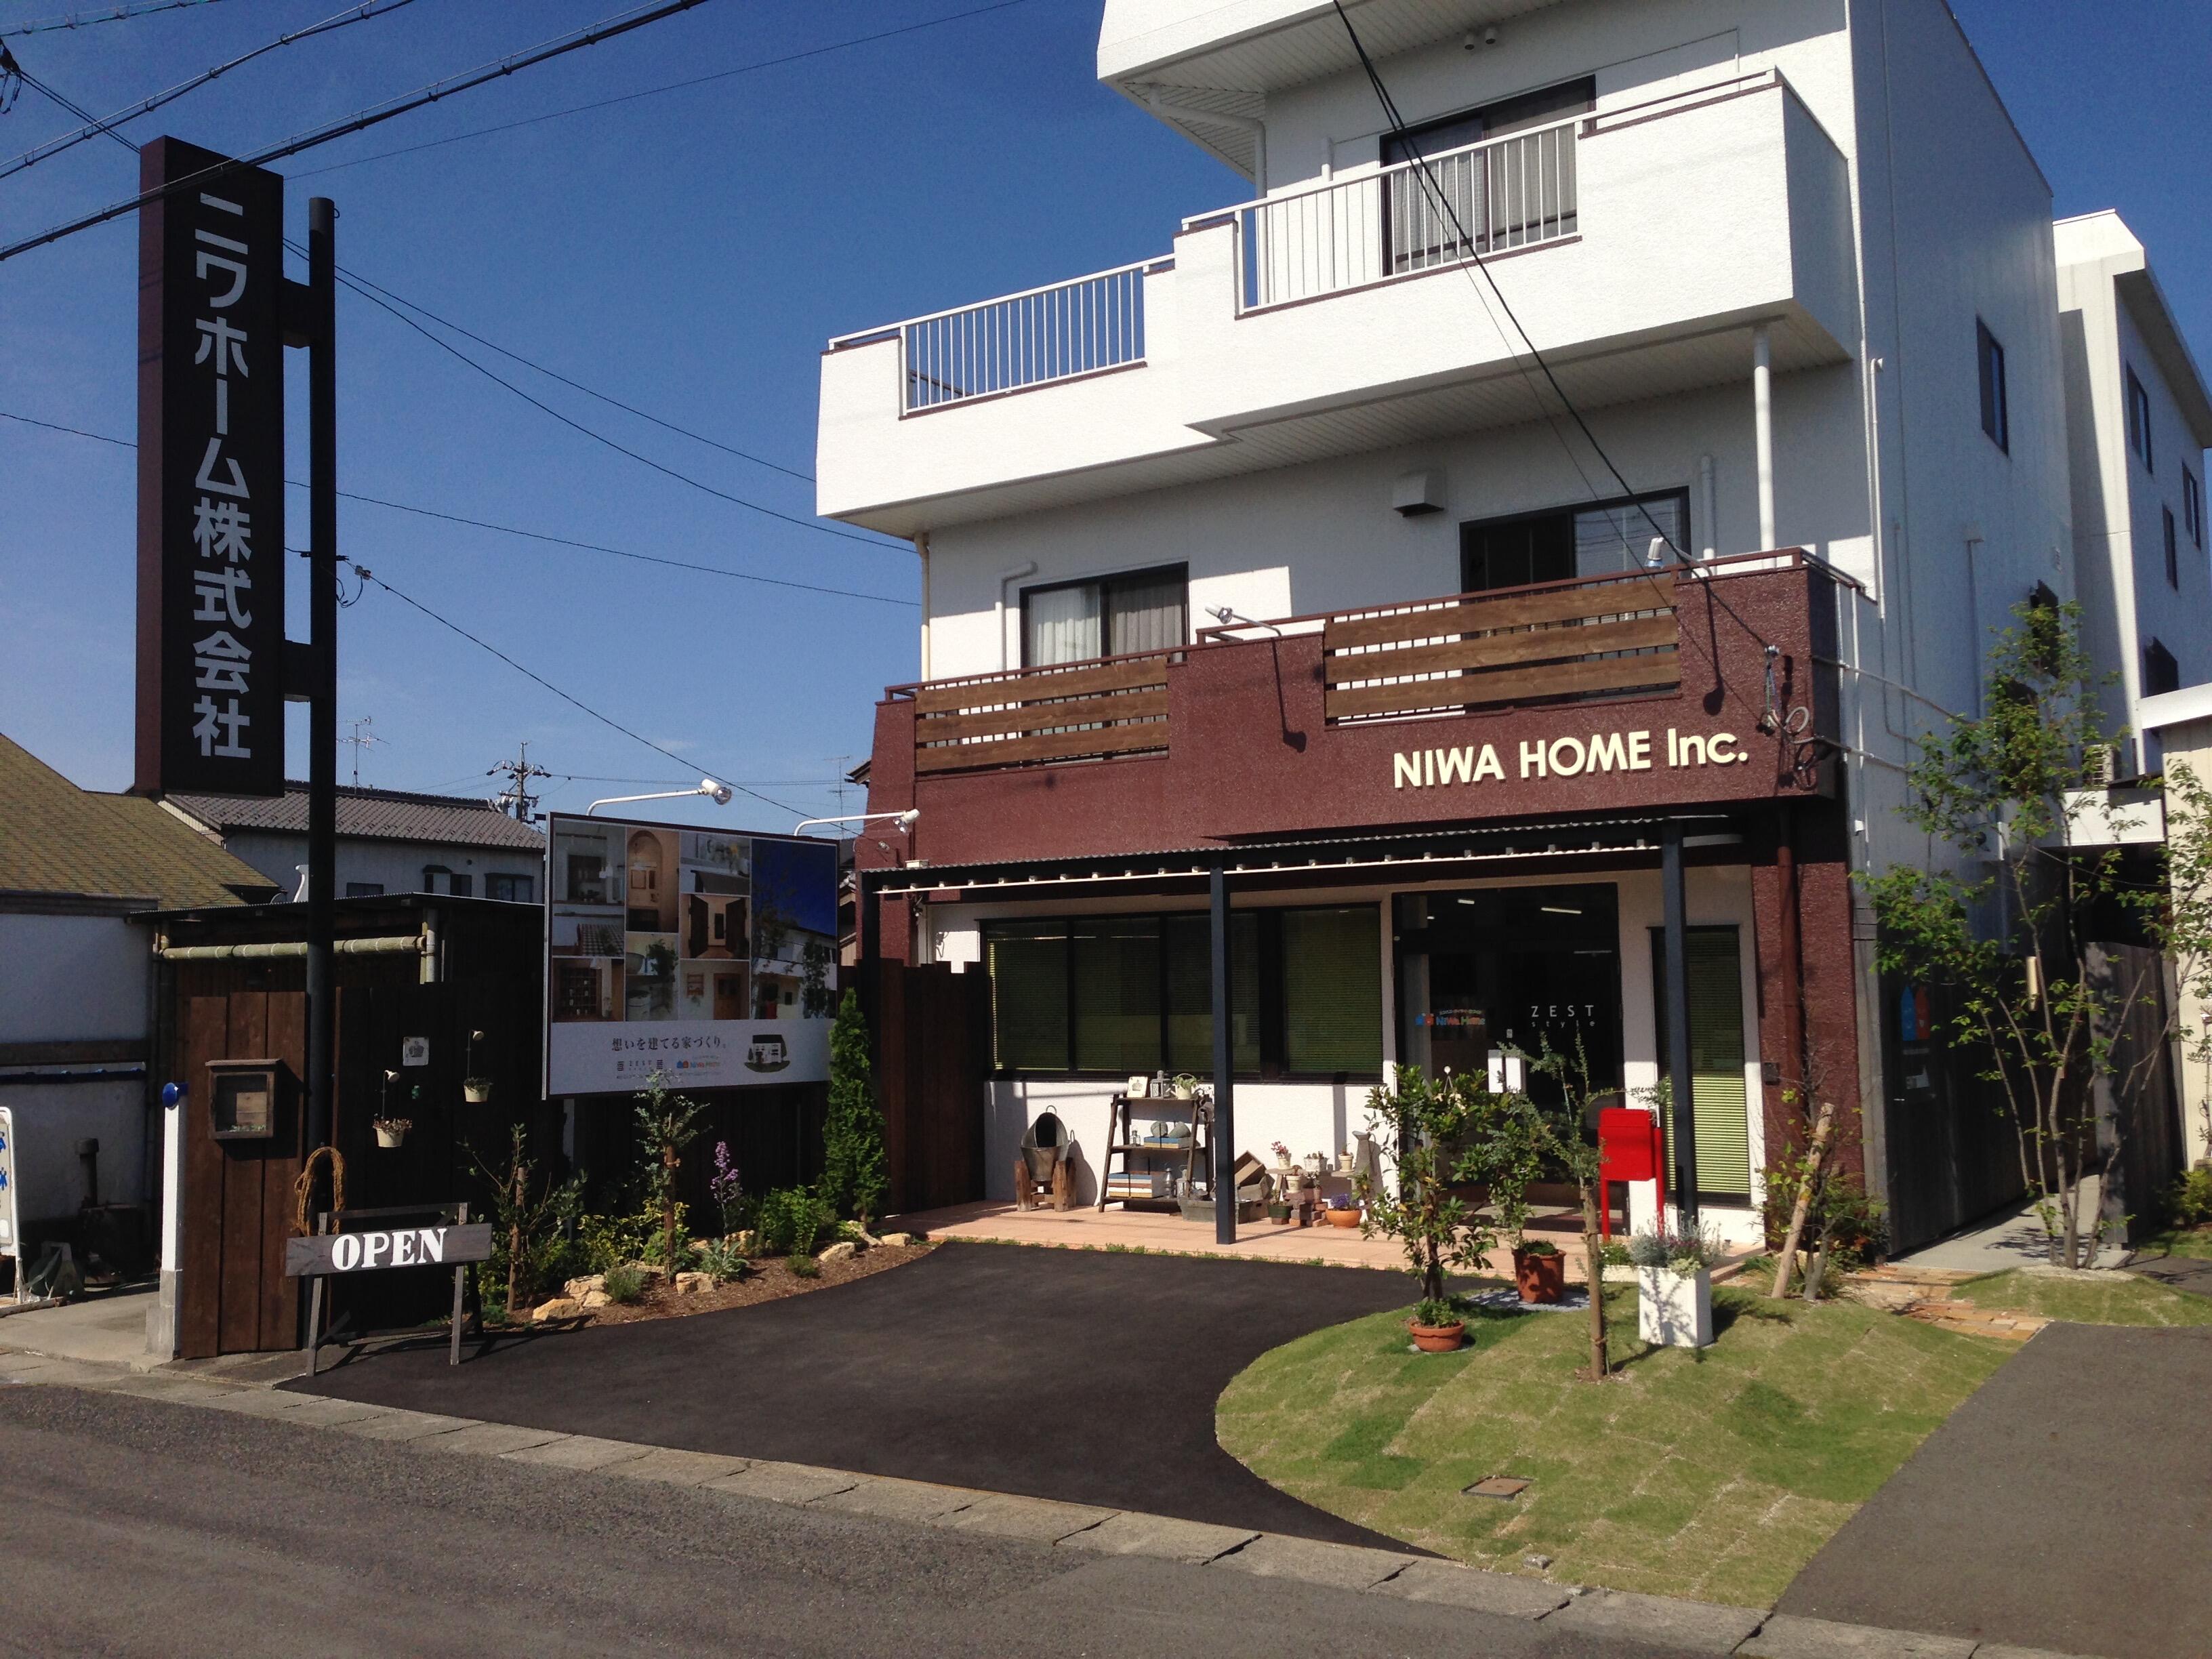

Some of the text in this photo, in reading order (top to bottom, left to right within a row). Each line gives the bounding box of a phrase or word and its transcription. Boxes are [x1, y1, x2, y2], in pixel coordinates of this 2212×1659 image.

[192, 192, 252, 759] ニワホーム株式会社
[1393, 728, 1748, 789] NIWA HOME Inc.
[1531, 1005, 1594, 1017] ZEST
[1532, 1020, 1595, 1029] style
[331, 1228, 447, 1271] OPEN
